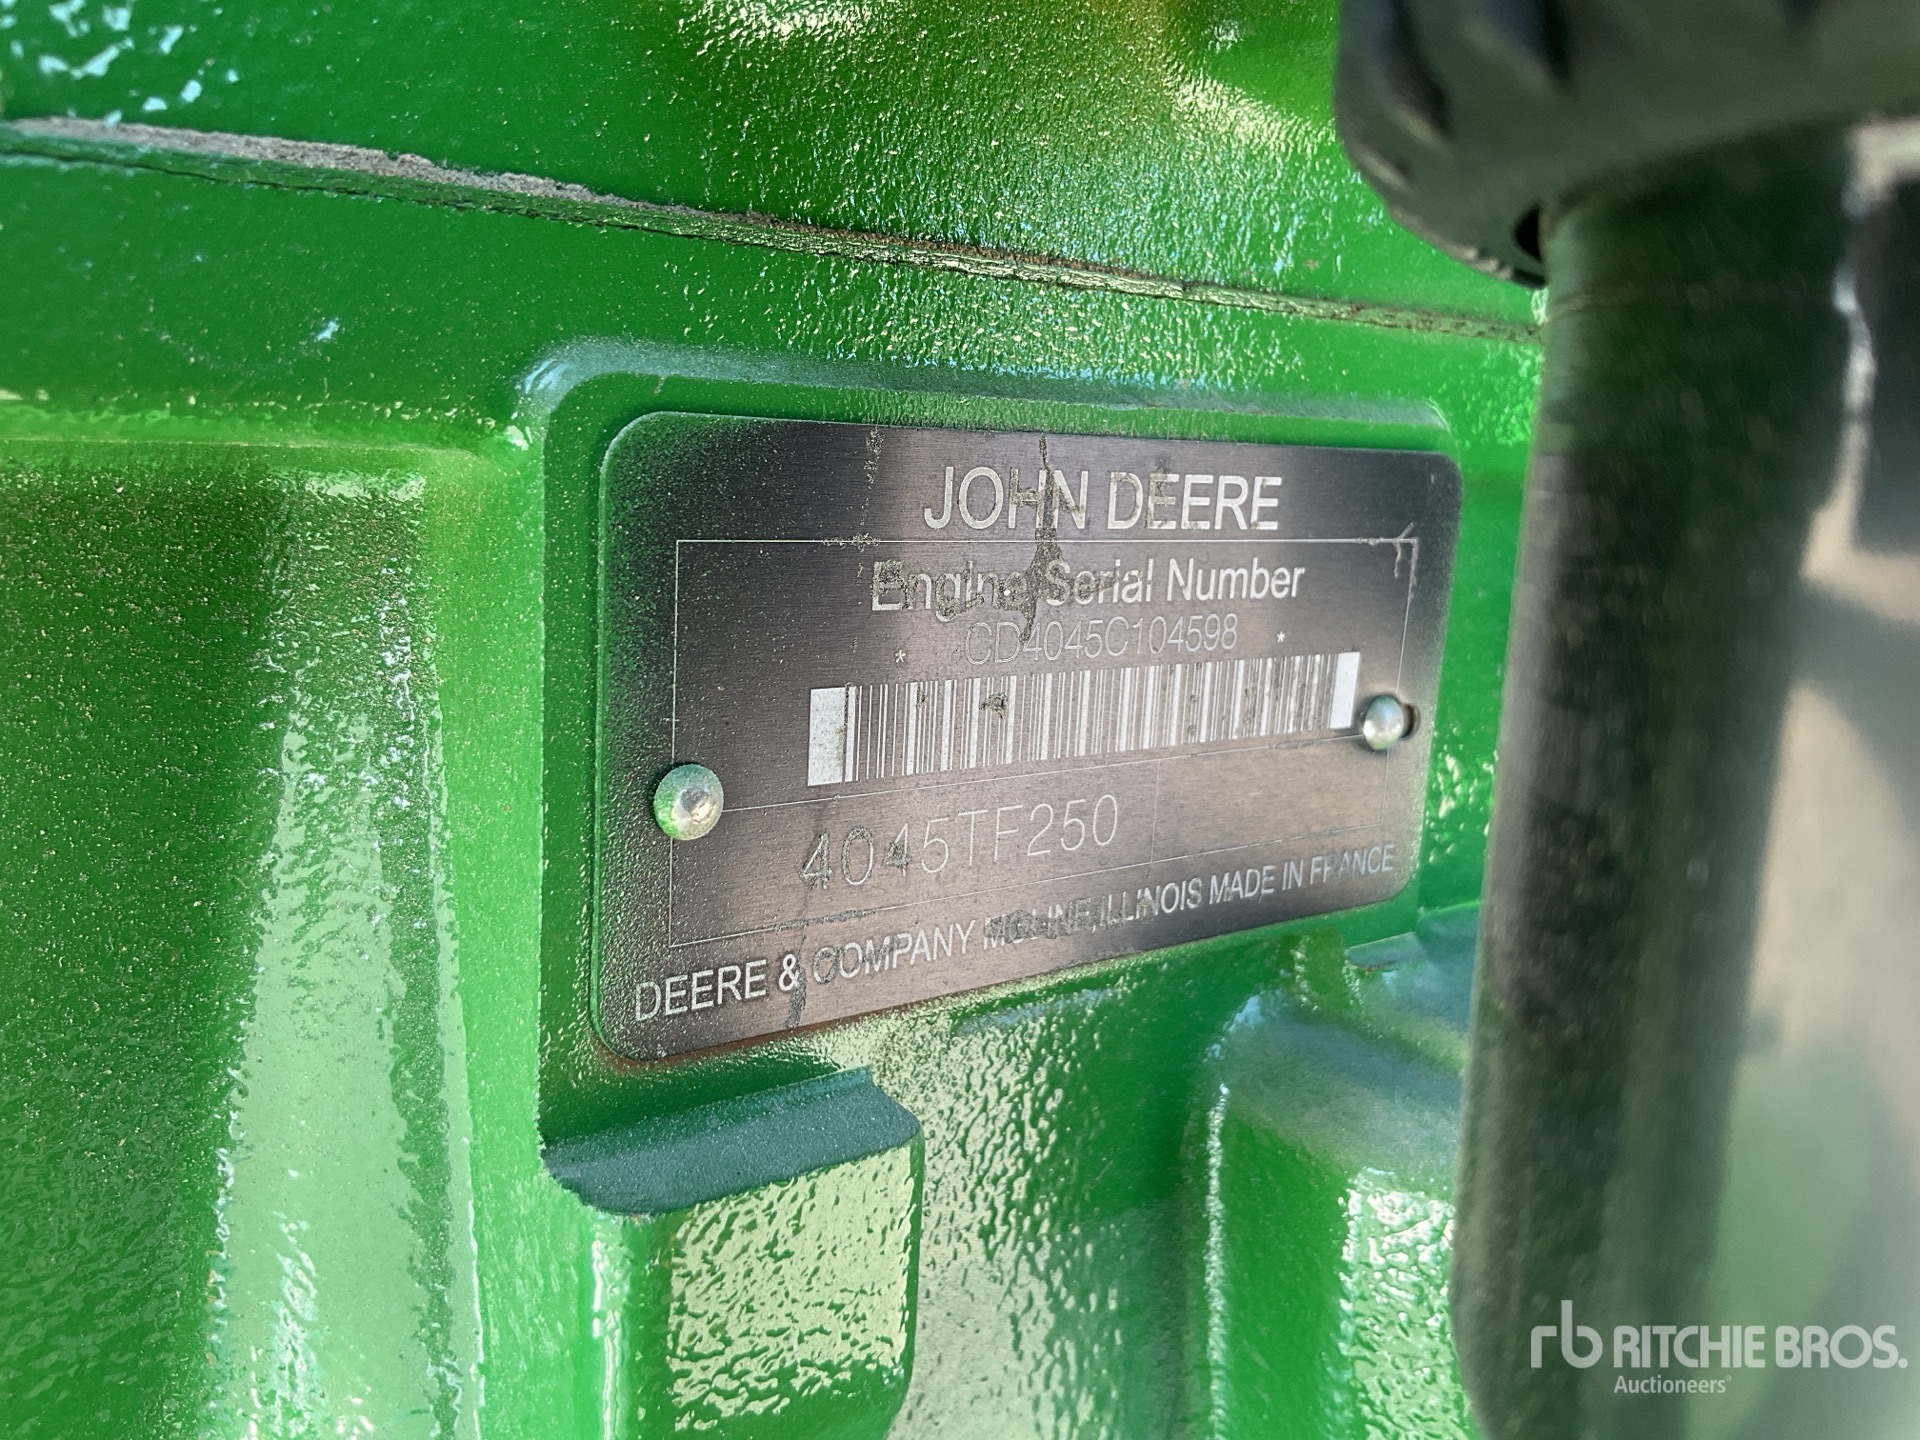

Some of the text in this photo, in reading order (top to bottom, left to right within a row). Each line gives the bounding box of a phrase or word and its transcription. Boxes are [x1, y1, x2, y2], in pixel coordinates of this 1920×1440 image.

[924, 466, 1283, 531] JOHN DEERE
[1044, 558, 1153, 606] Serial
[1166, 559, 1306, 604] Number
[965, 612, 1238, 665] CD4045C104598
[800, 794, 1118, 890] 4045TF250
[635, 959, 767, 1022] DEERE
[778, 953, 801, 992] &
[812, 919, 976, 985] COMPANY
[1209, 864, 1277, 905] MADE
[1282, 858, 1305, 893] IN
[1309, 842, 1398, 885] FRANCE
